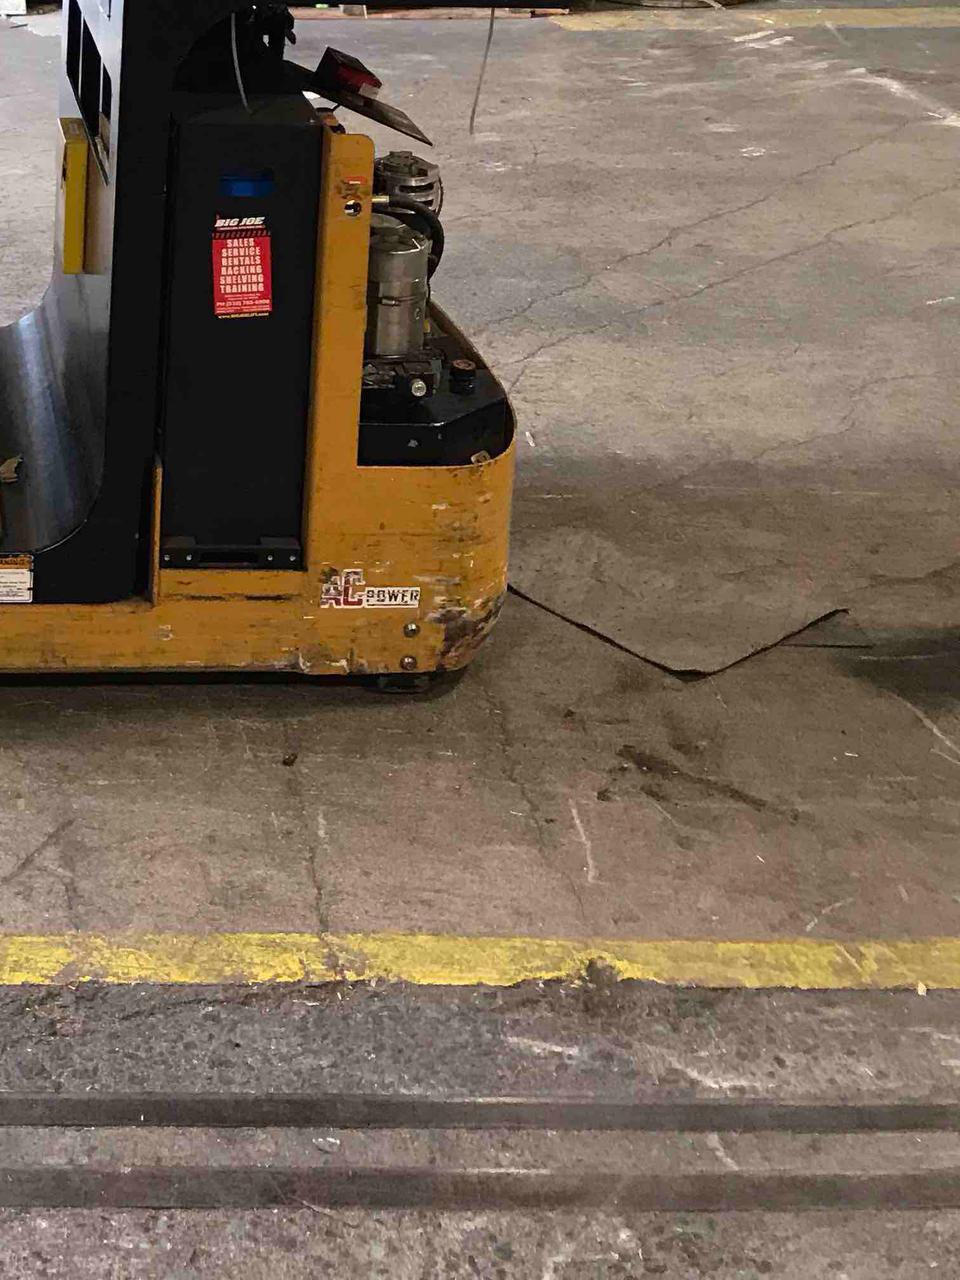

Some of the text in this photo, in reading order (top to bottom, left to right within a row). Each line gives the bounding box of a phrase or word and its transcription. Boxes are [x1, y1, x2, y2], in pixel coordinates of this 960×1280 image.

[214, 216, 265, 227] BIG JOE
[226, 238, 254, 248] SALES
[221, 247, 260, 257] SERVICE
[222, 256, 261, 266] RENTALS
[221, 265, 262, 275] RACKING
[219, 275, 264, 285] SHELVING
[220, 284, 264, 294] TRAINING
[366, 589, 420, 603] POWER
